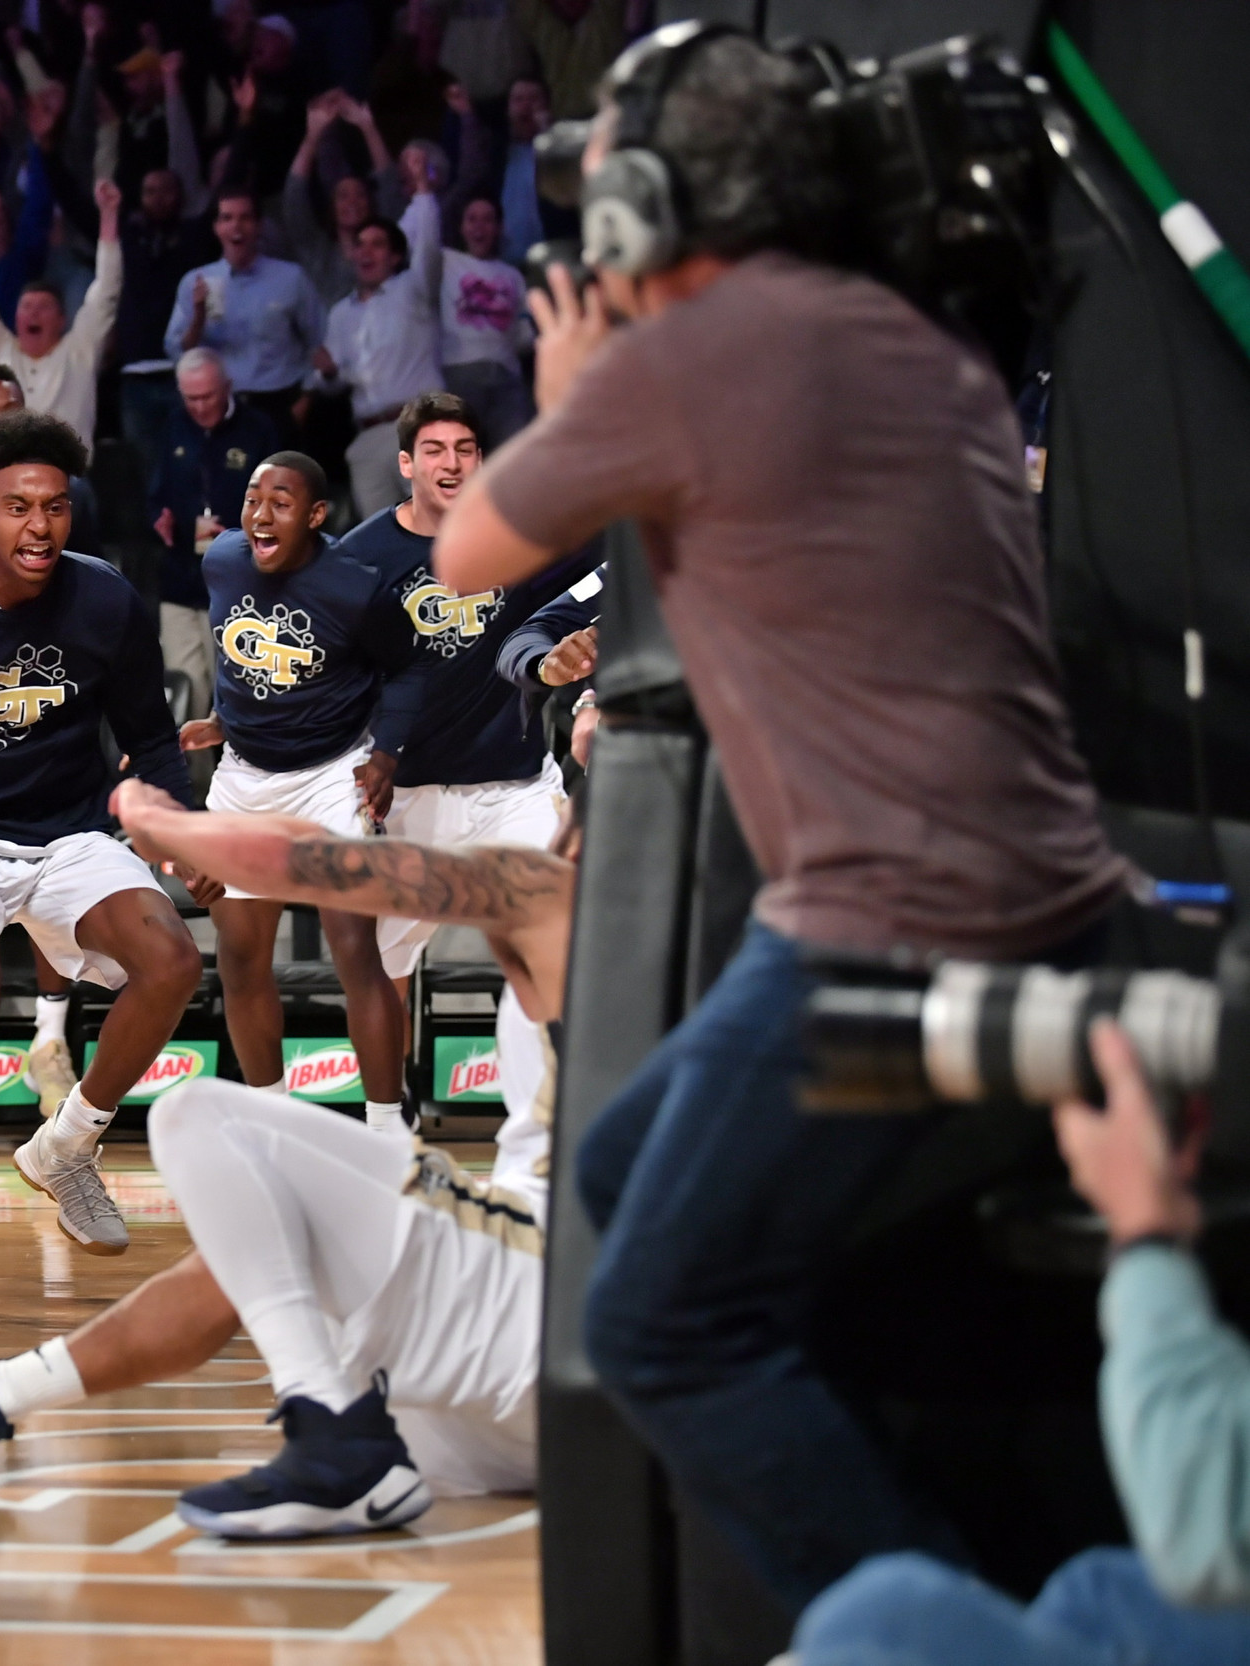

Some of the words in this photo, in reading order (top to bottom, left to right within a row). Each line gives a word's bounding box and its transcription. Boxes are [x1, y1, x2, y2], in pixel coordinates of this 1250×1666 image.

[404, 584, 496, 638] GT
[222, 617, 313, 685] GT
[137, 1055, 195, 1085] MAN
[287, 1056, 360, 1092] IBMA
[448, 1062, 500, 1097] LIB
